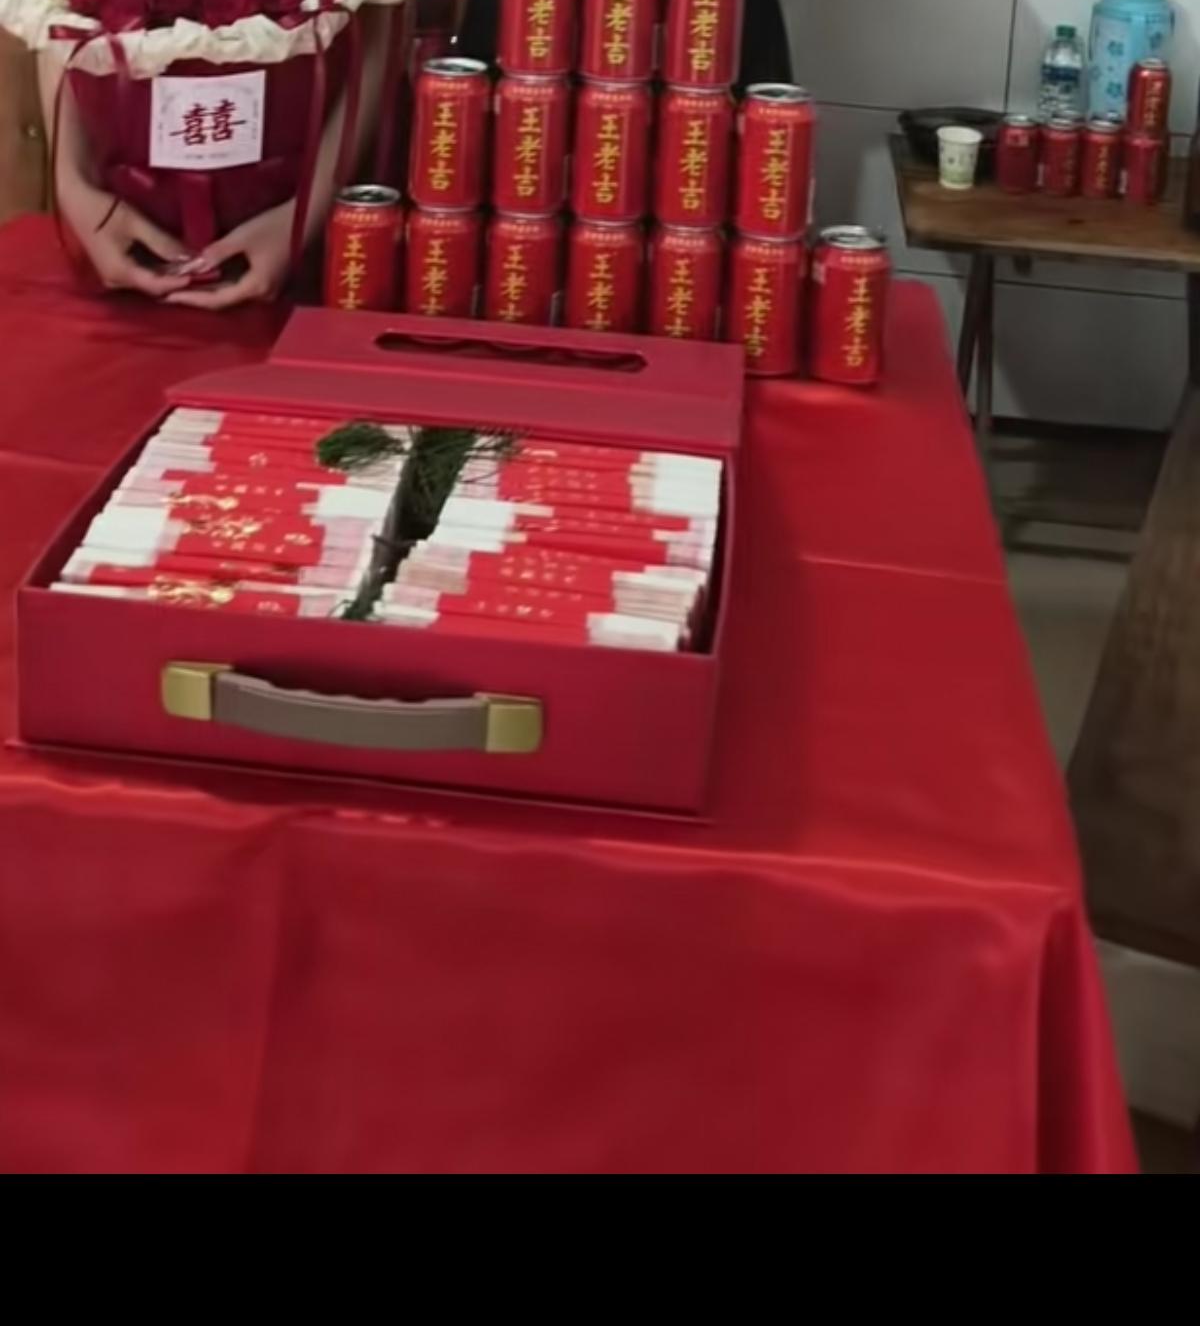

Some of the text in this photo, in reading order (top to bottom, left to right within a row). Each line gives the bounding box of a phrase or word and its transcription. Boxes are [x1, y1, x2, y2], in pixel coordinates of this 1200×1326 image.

[428, 101, 457, 190] 王老吉
[513, 107, 542, 196] 王老吉
[592, 114, 621, 203] 王老吉
[678, 120, 708, 209] 王老吉
[759, 130, 789, 219] 王老吉
[744, 268, 772, 356] 王老吉
[845, 277, 870, 366] 王老吉
